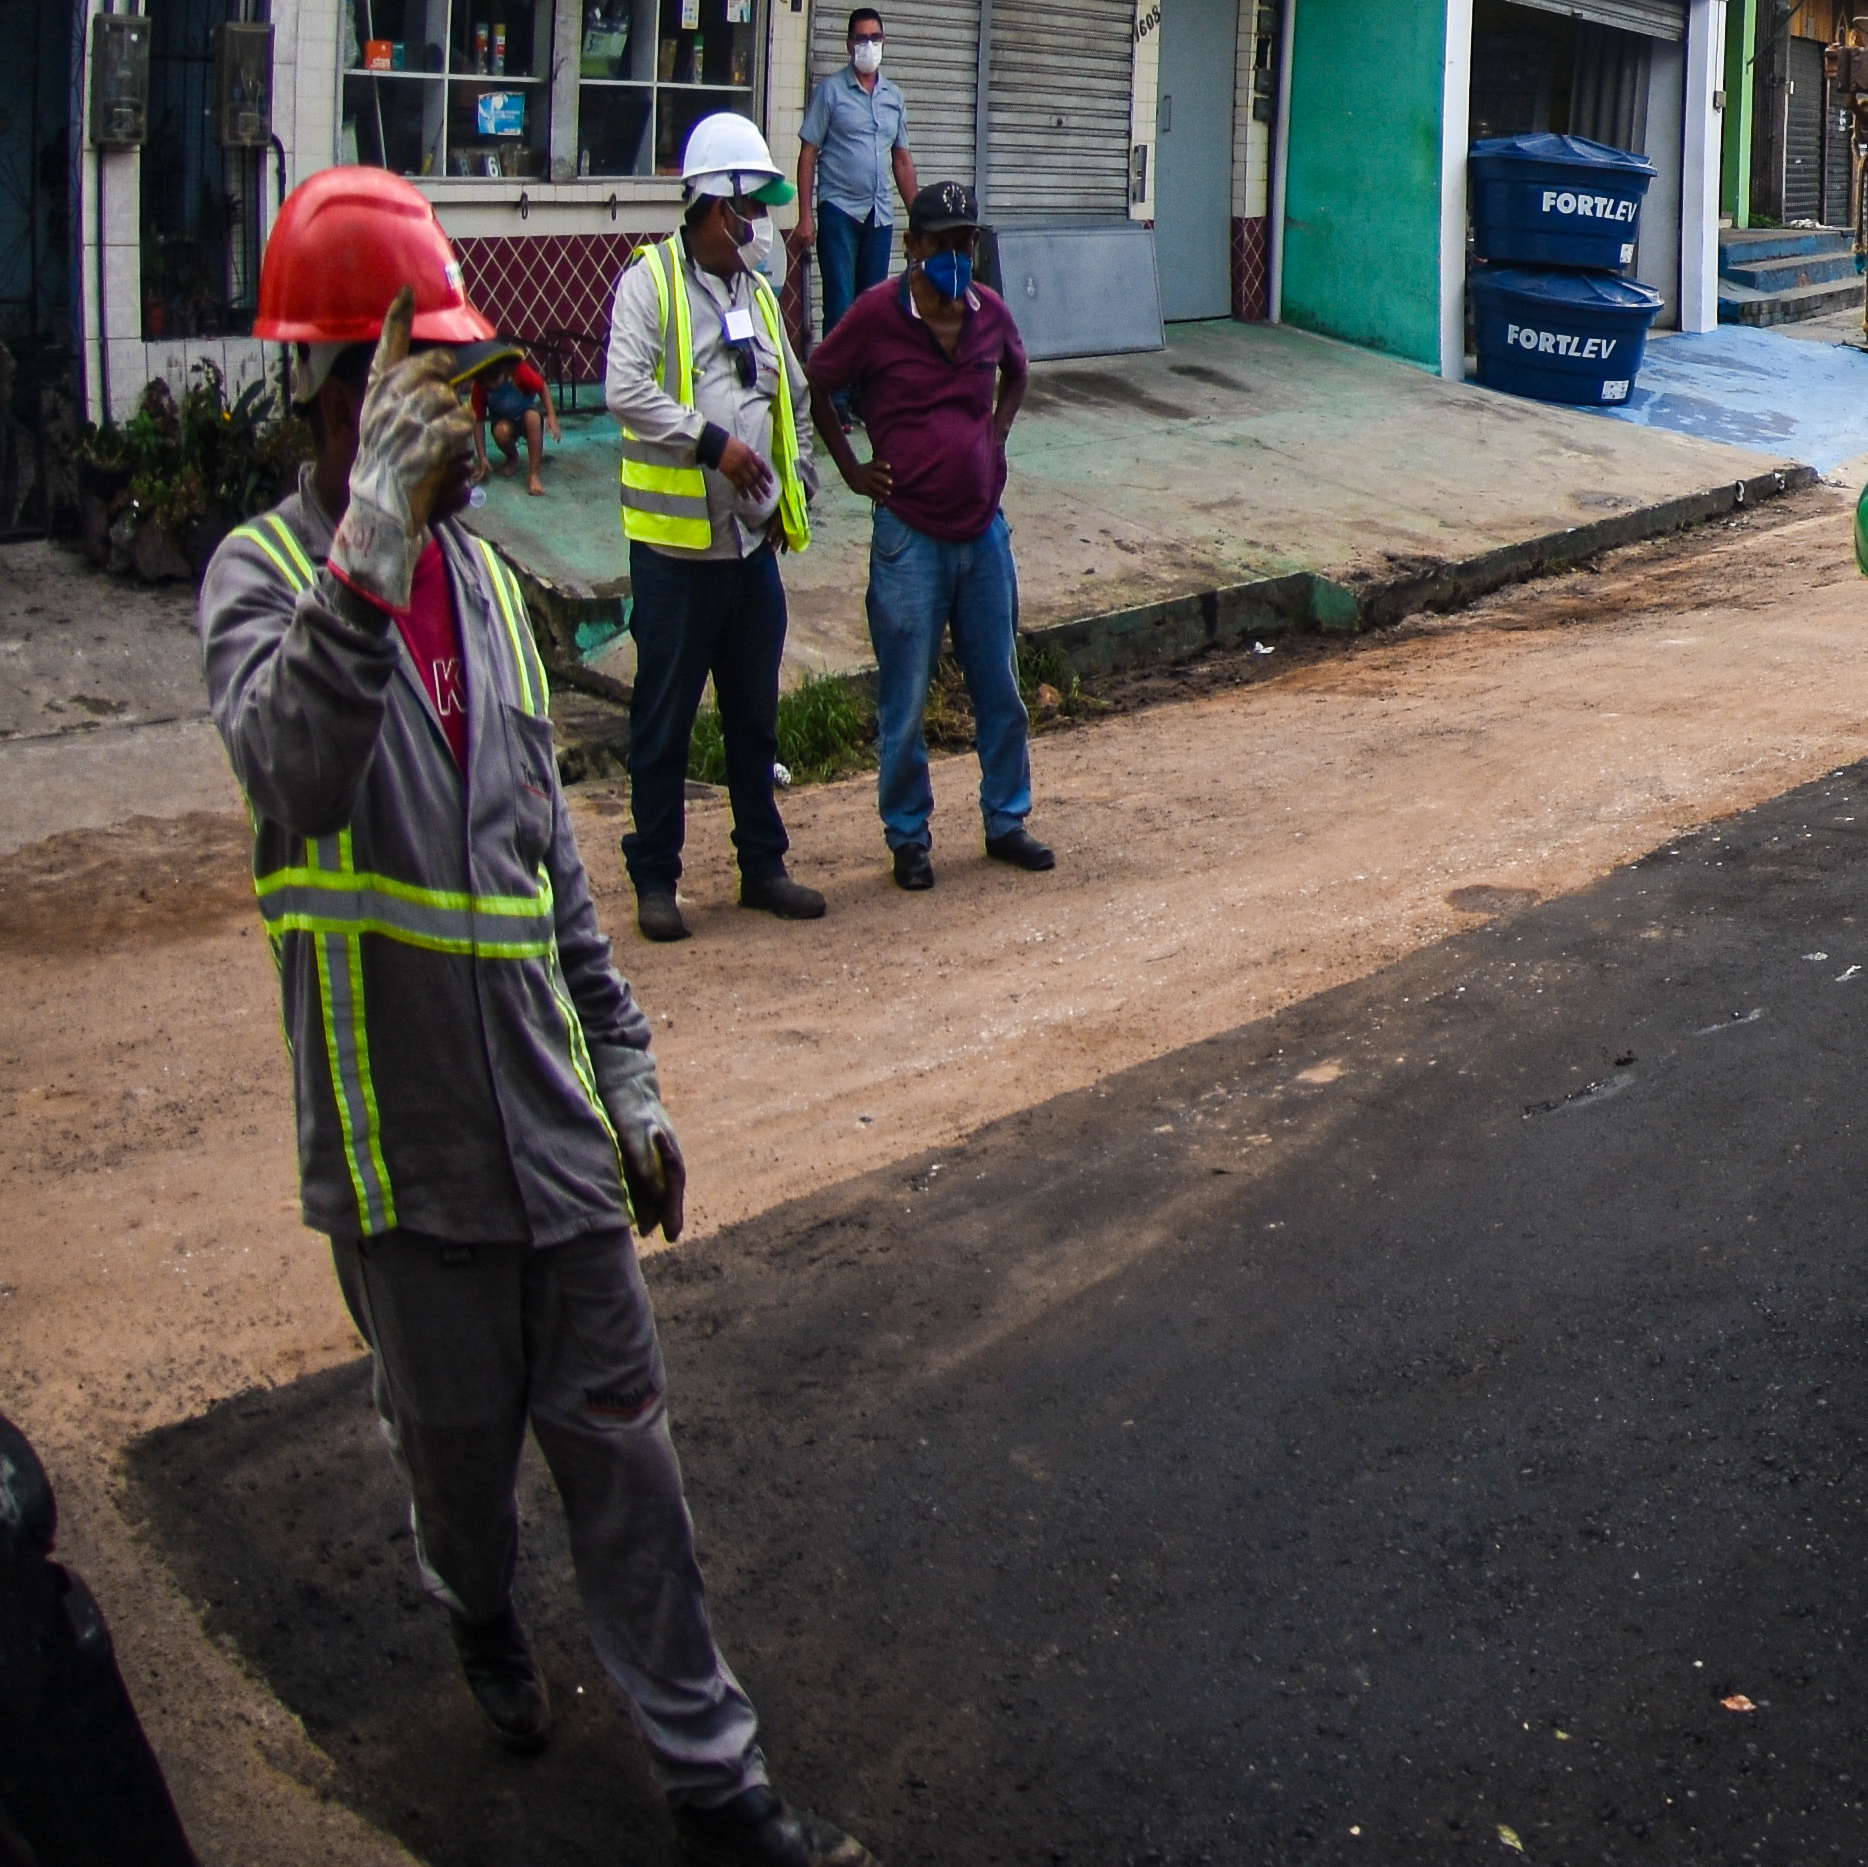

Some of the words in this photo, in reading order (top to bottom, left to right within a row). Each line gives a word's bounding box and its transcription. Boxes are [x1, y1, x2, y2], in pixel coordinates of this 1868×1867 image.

[1542, 191, 1638, 224] FORTLEV
[1506, 323, 1617, 360] FORTLEV
[432, 659, 468, 716] K
